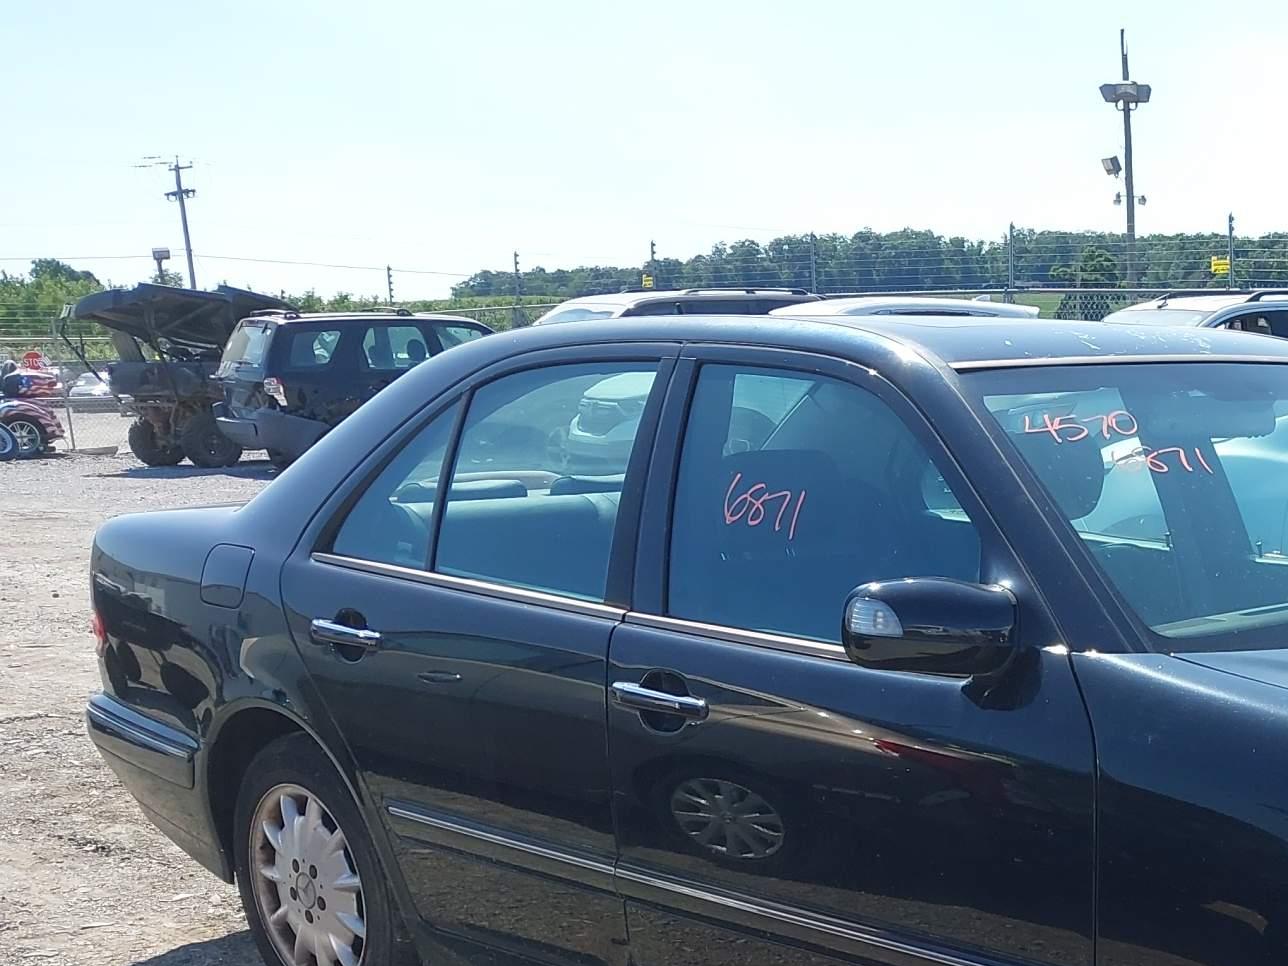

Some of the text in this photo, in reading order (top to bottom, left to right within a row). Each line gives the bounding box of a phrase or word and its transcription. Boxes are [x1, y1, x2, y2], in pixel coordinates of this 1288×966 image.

[24, 358, 43, 367] STO
[1024, 410, 1138, 443] 4570
[724, 473, 806, 540] 6871
